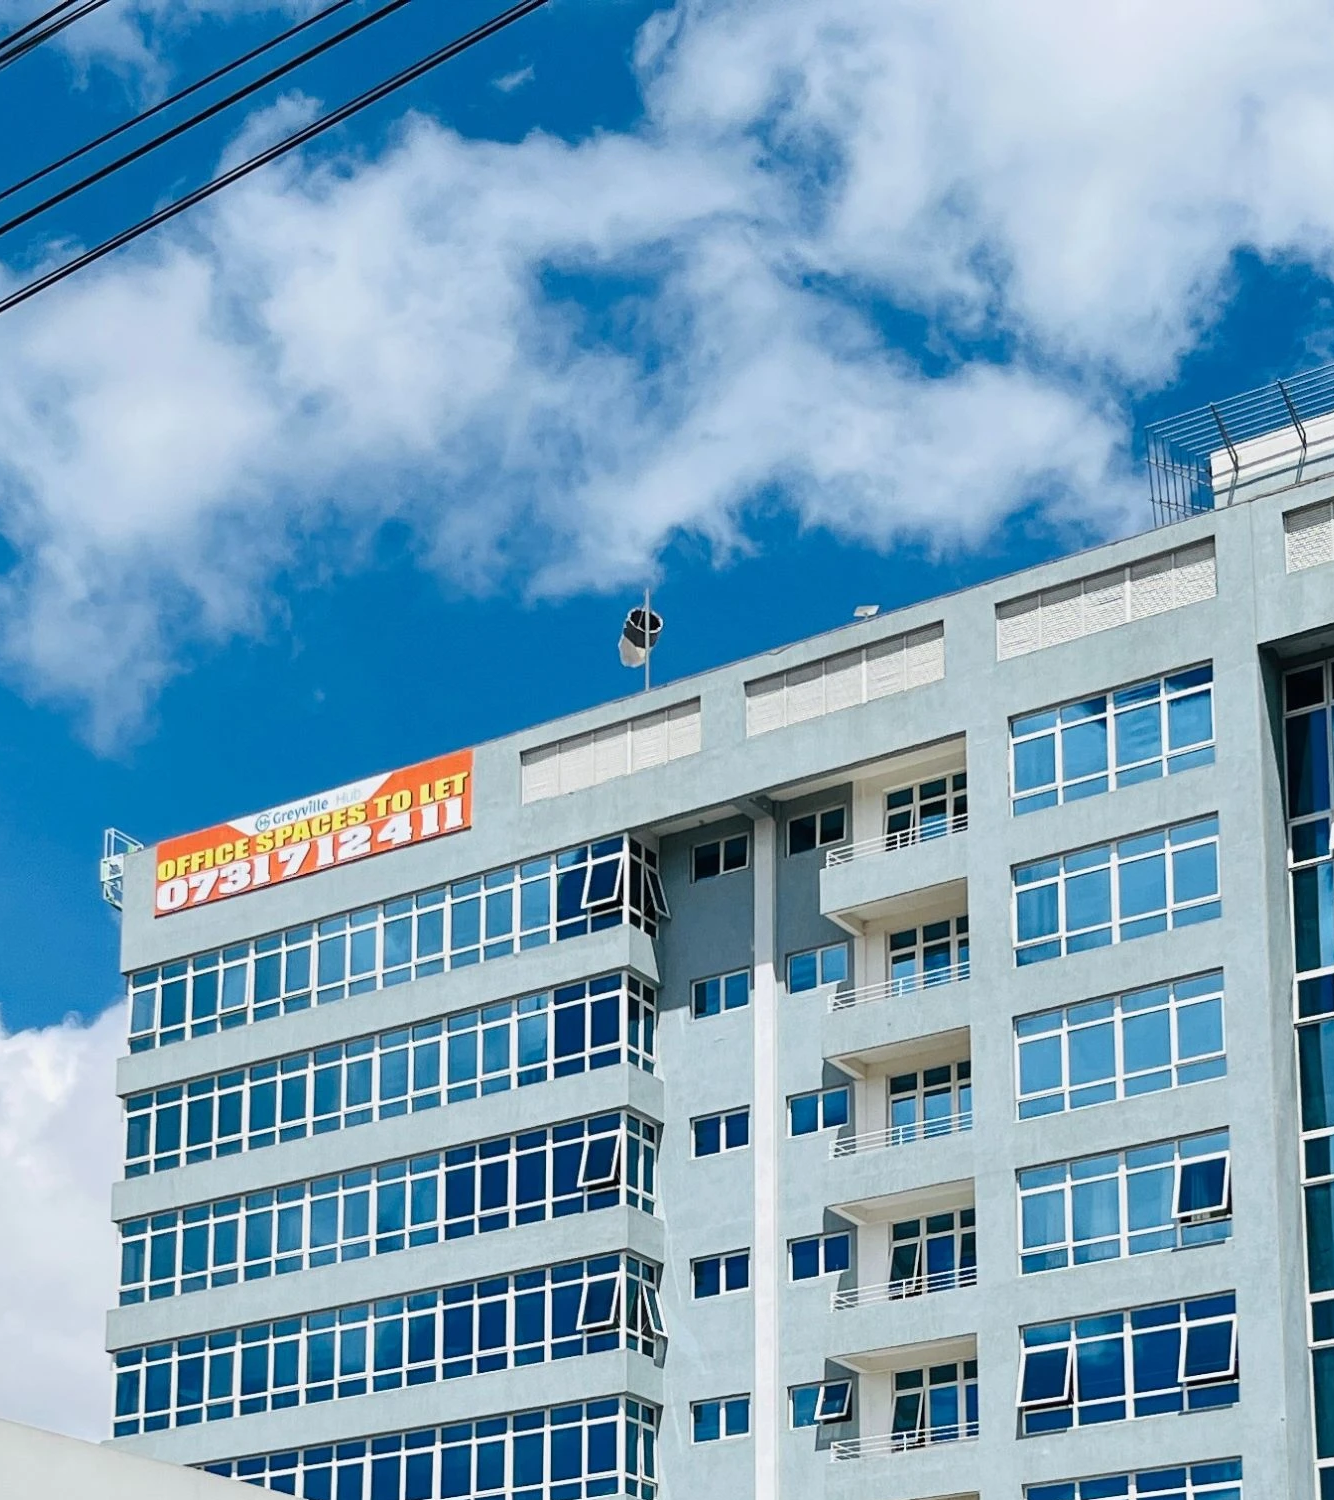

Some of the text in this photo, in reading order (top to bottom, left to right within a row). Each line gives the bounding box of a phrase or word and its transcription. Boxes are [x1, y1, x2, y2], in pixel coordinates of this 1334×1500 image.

[157, 771, 470, 882] OFFICE SPACES TO LET
[273, 799, 328, 826] Greyville
[336, 788, 362, 806] Hub
